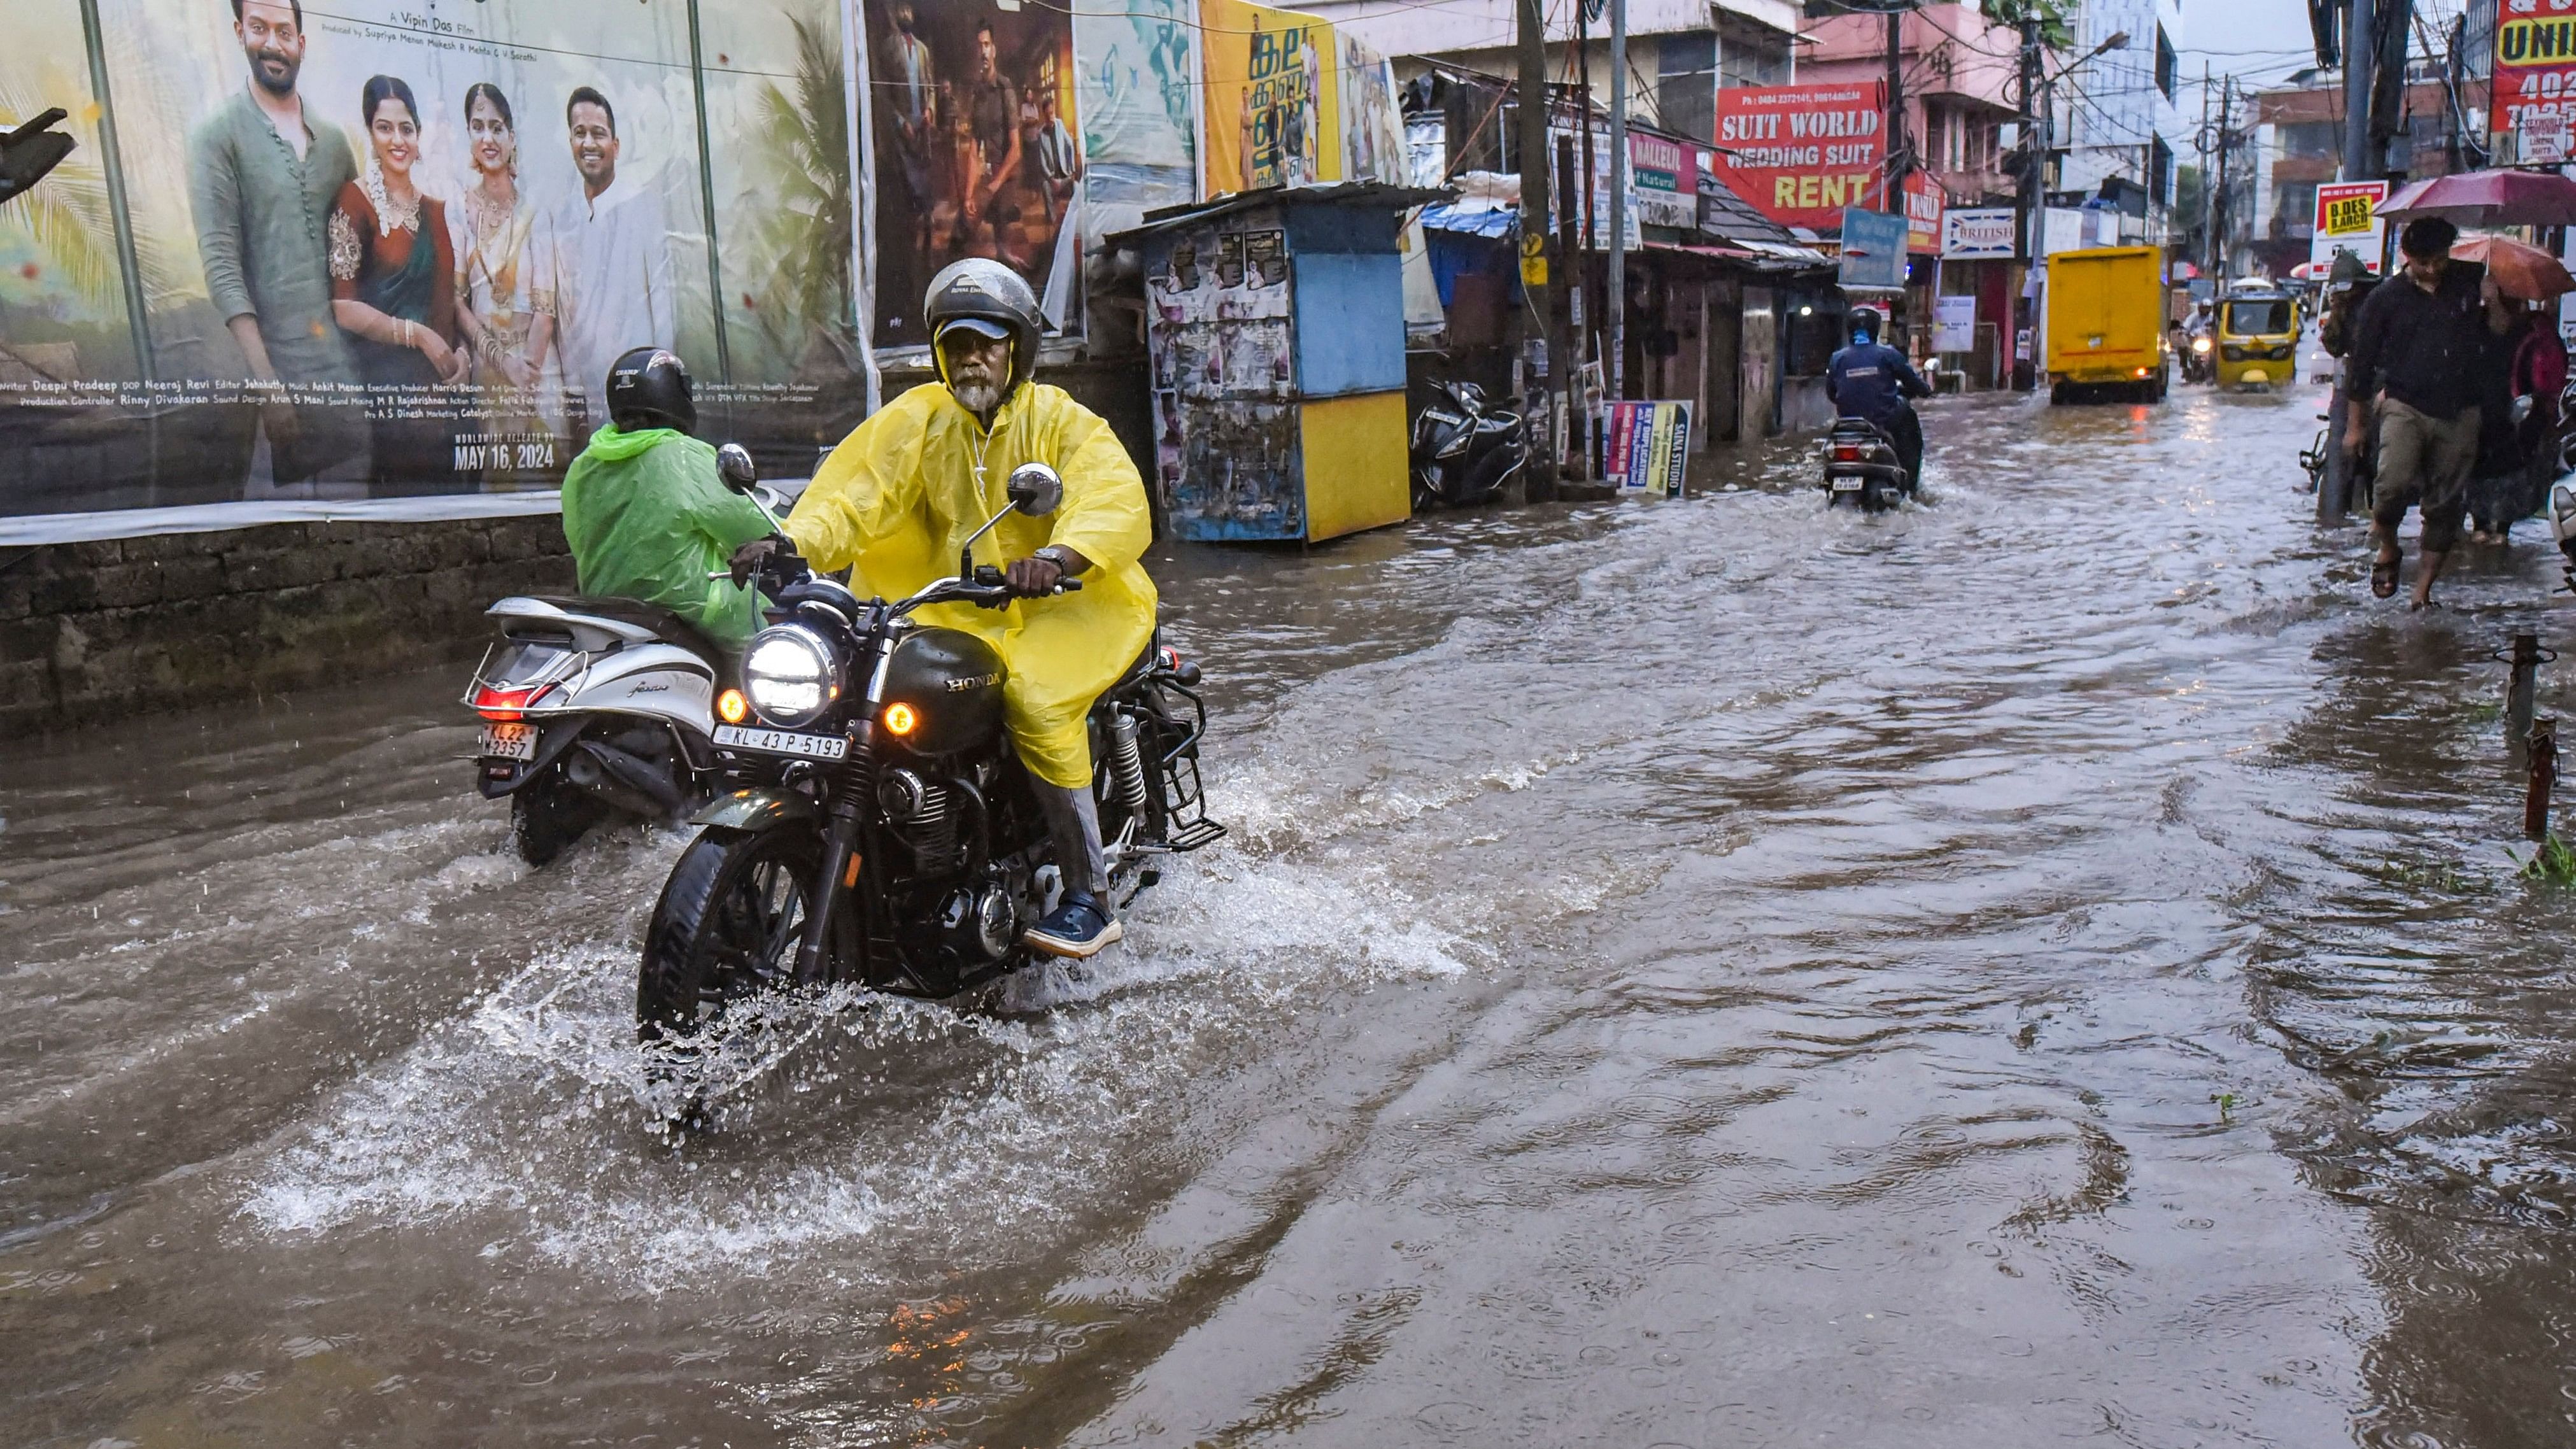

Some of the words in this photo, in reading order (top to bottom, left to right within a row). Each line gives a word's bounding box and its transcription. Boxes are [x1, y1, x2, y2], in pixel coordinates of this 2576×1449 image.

[390, 13, 397, 23] A
[400, 12, 428, 30] Vipin
[433, 17, 453, 32] Das
[456, 24, 476, 34] Film
[365, 27, 397, 42] Supriya
[400, 33, 424, 45] Menon
[427, 38, 456, 50] Mukesh
[460, 43, 465, 52] R
[469, 45, 491, 55] Mehta
[510, 50, 537, 62] Sarathi
[2502, 22, 2576, 60] UNI
[1722, 115, 1781, 141] SUIT
[1789, 110, 1878, 138] WORLD
[1825, 144, 1874, 166] SUIT
[1643, 172, 1676, 188] Natural
[1774, 173, 1870, 208] RENT
[1960, 227, 2013, 238] BRITISH
[33, 380, 67, 394] Deepu
[73, 380, 117, 394] Pradeep
[145, 380, 181, 393] Neeraj
[187, 379, 209, 390] Revi
[215, 380, 241, 390] Editor
[244, 379, 285, 393] Johnkutty
[312, 381, 334, 392] Ankit
[337, 382, 364, 392] Menon
[367, 383, 399, 392] Executive
[401, 383, 429, 393] Producer
[432, 383, 456, 393] Harris
[20, 397, 67, 406] Production
[71, 396, 115, 406] Controller
[120, 394, 150, 408] Rinny
[155, 394, 208, 406] Divakaran
[213, 395, 238, 404] Sound
[271, 394, 291, 404] Arun
[294, 394, 300, 404] S
[304, 394, 325, 405] Mani
[328, 396, 348, 406] Sound
[377, 396, 385, 405] M
[388, 396, 394, 405] R
[397, 395, 447, 407] Rajakrishnan
[378, 409, 385, 418] A
[388, 409, 393, 418] S
[397, 409, 424, 419] Dinesh
[460, 409, 492, 420] Catalyst
[1645, 407, 1653, 425] KEY
[455, 433, 503, 444] WORLDWIDE
[507, 433, 541, 442] RELEASE
[1672, 423, 1686, 451] SAINA
[455, 446, 486, 470] MAY
[491, 444, 513, 472] 16,
[517, 444, 555, 469] 2024
[1637, 426, 1651, 484] DUPLICATING
[1669, 452, 1682, 489] STUDIO
[947, 672, 1000, 692] HONDA
[733, 729, 749, 746] KL
[761, 733, 781, 749] 43
[785, 735, 795, 751] P
[803, 737, 843, 756] 5193
